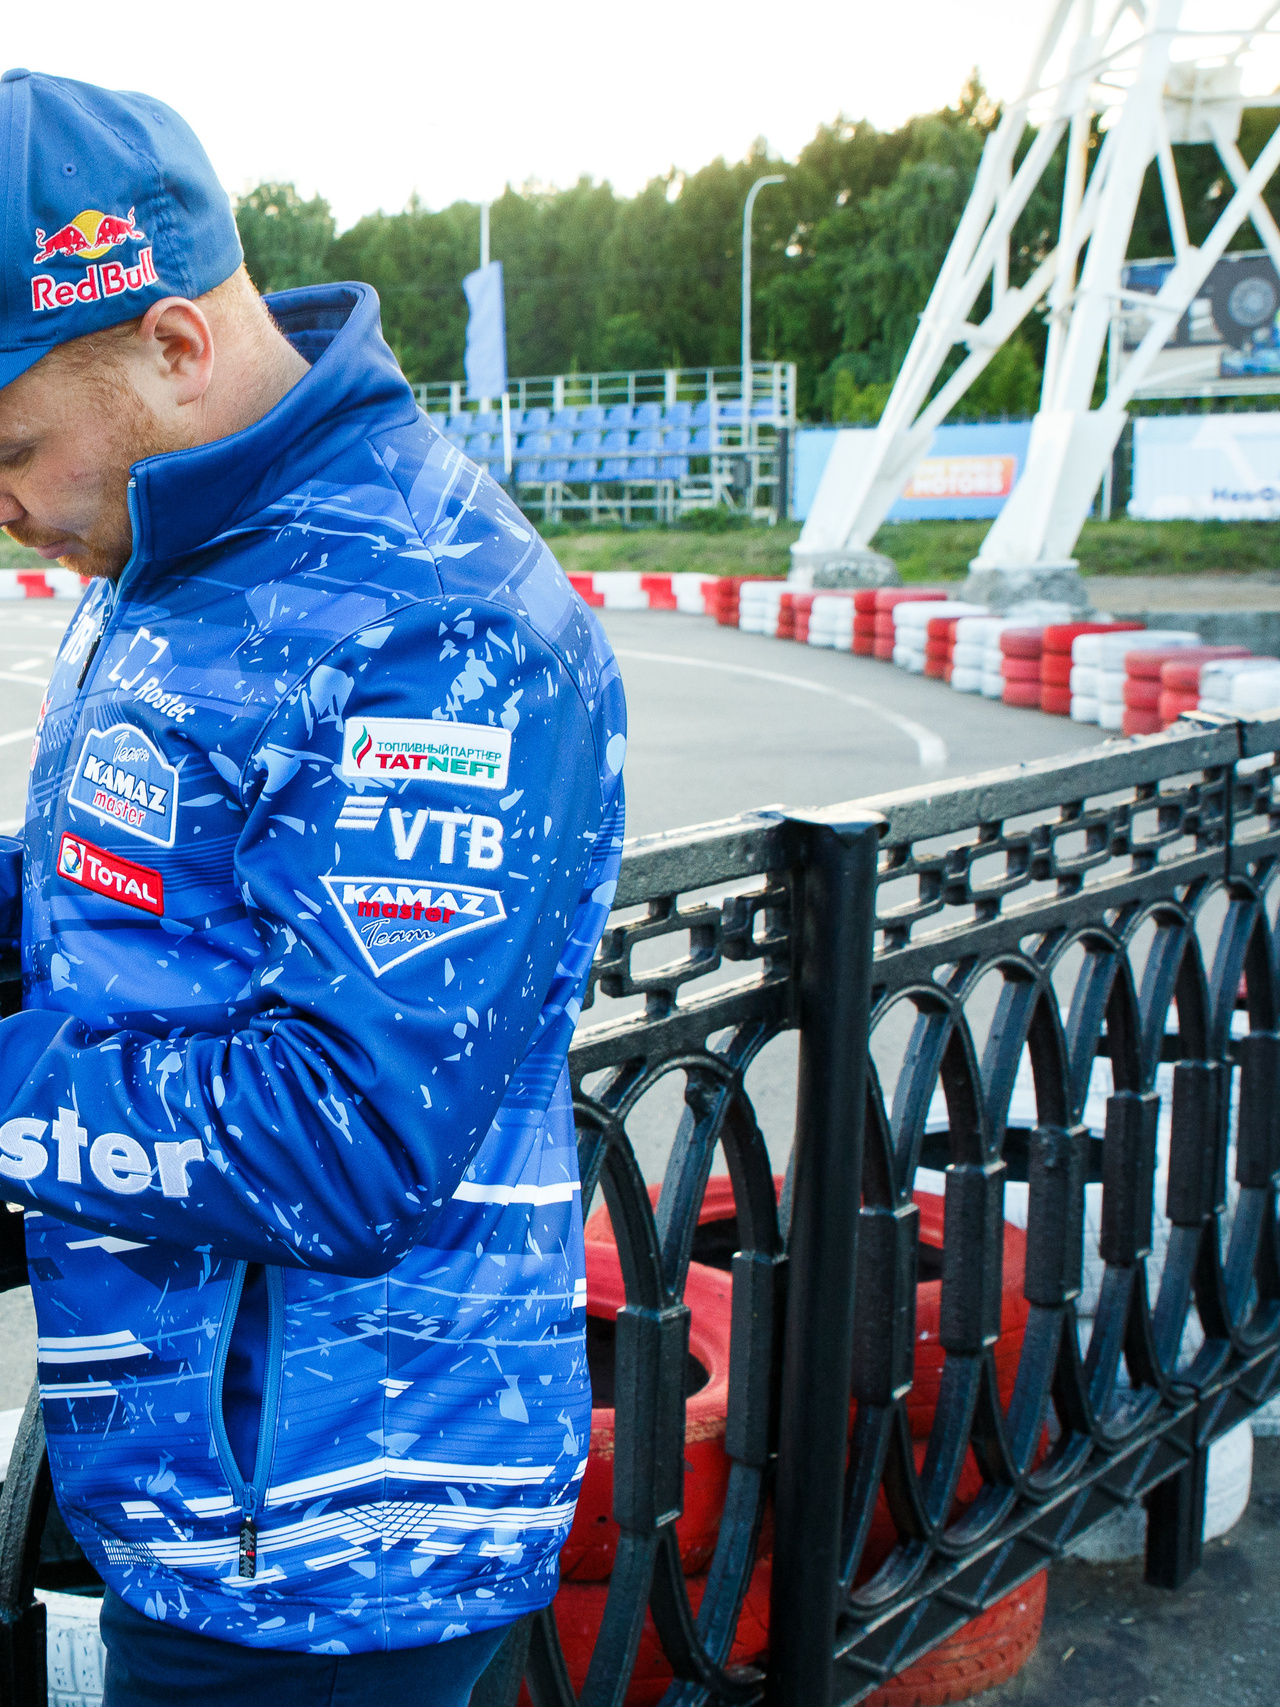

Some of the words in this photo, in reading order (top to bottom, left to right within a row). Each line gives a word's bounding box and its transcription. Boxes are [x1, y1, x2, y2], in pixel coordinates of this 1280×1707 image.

[32, 263, 99, 312] Red
[100, 246, 160, 299] Bull
[133, 676, 196, 723] Rostec
[113, 731, 150, 763] Team
[377, 741, 449, 755] ТОПЛИВНЫЙ
[450, 746, 502, 762] ПАРТНЕР
[375, 753, 501, 779] TATNEFT
[82, 753, 169, 816] KAMAZ
[93, 788, 147, 827] master
[389, 807, 504, 870] VTB
[86, 854, 158, 905] TOTAL
[342, 884, 485, 917] KAMAZ
[357, 901, 456, 923] master
[360, 918, 436, 948] Team
